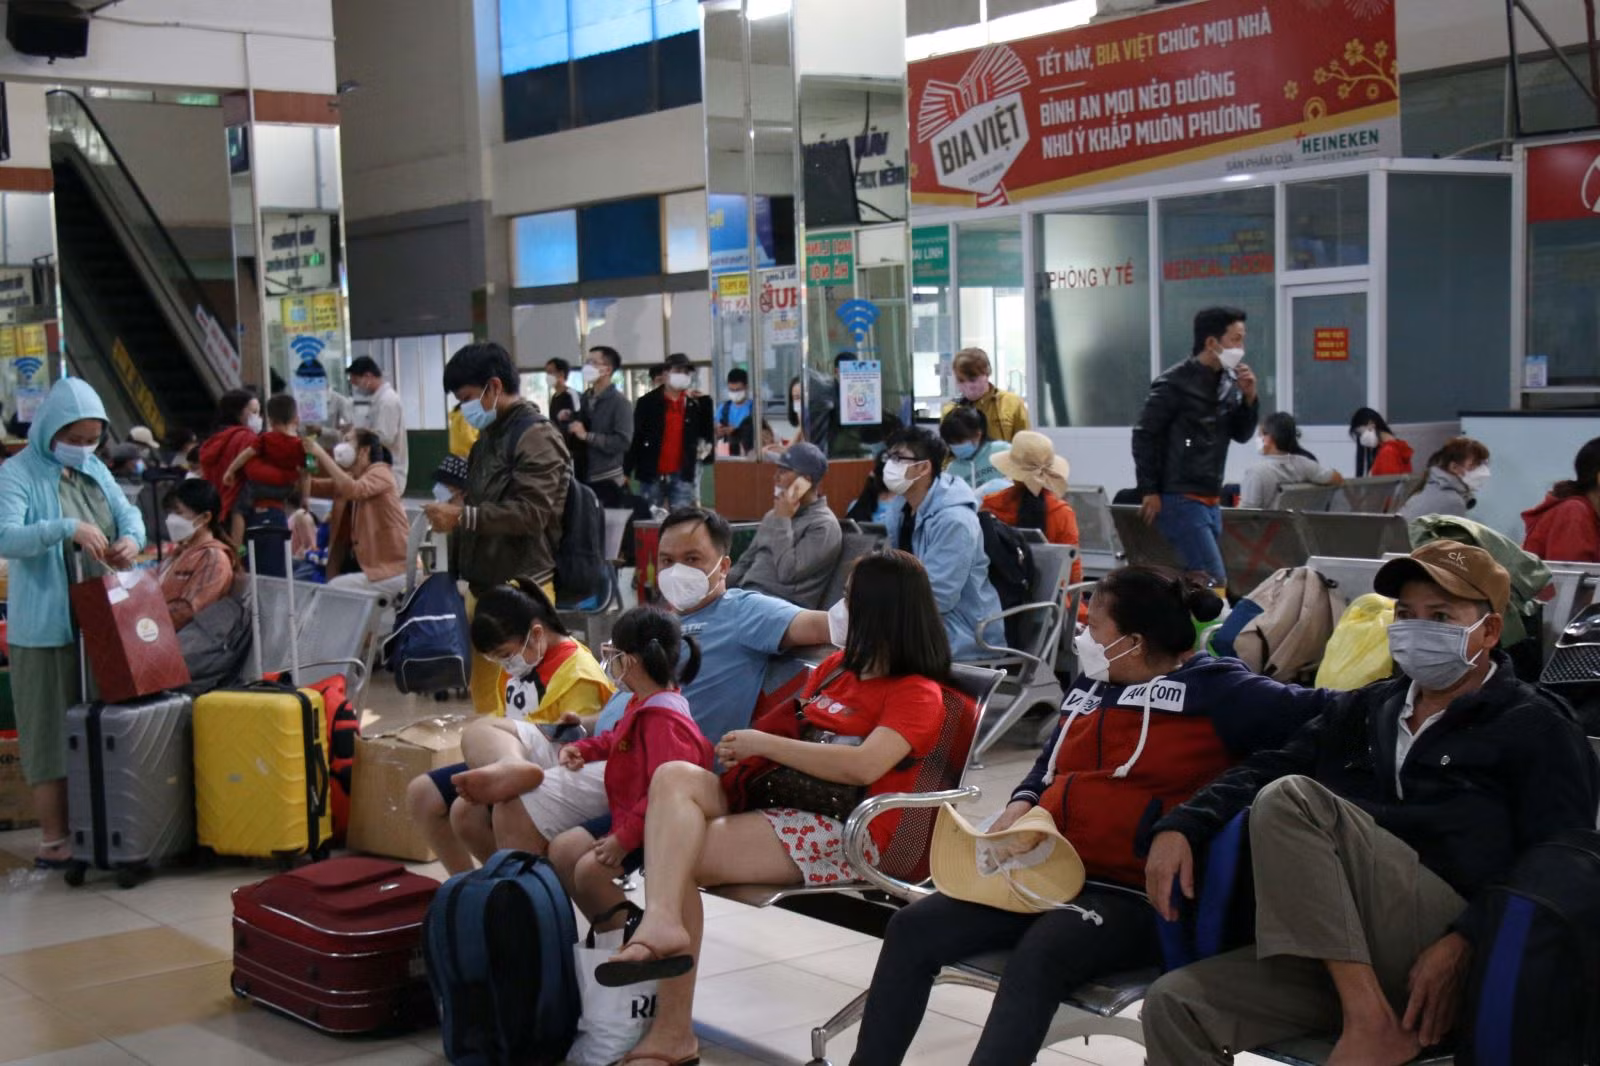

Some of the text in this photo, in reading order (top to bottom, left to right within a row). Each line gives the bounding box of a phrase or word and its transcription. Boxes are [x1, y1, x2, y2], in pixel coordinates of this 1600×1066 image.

[1037, 6, 1272, 77] TẾT NÀY, BIA VIỆT CHÚC MỌI NHÀ
[1040, 97, 1076, 127] BÌNH
[1079, 95, 1101, 120] AN
[1104, 88, 1134, 119] MỌI
[1175, 71, 1236, 105] ĐƯỜNG
[937, 129, 977, 177] BIA
[973, 102, 1020, 156] VIỆT
[1042, 133, 1074, 159] NHƯ
[1075, 126, 1085, 155] Ý
[1135, 113, 1185, 146] MUÔN
[1188, 103, 1262, 138] PHƯƠNG
[1302, 128, 1380, 154] HEINEKEN
[1048, 257, 1134, 288] PHÒNG Y TẾ
